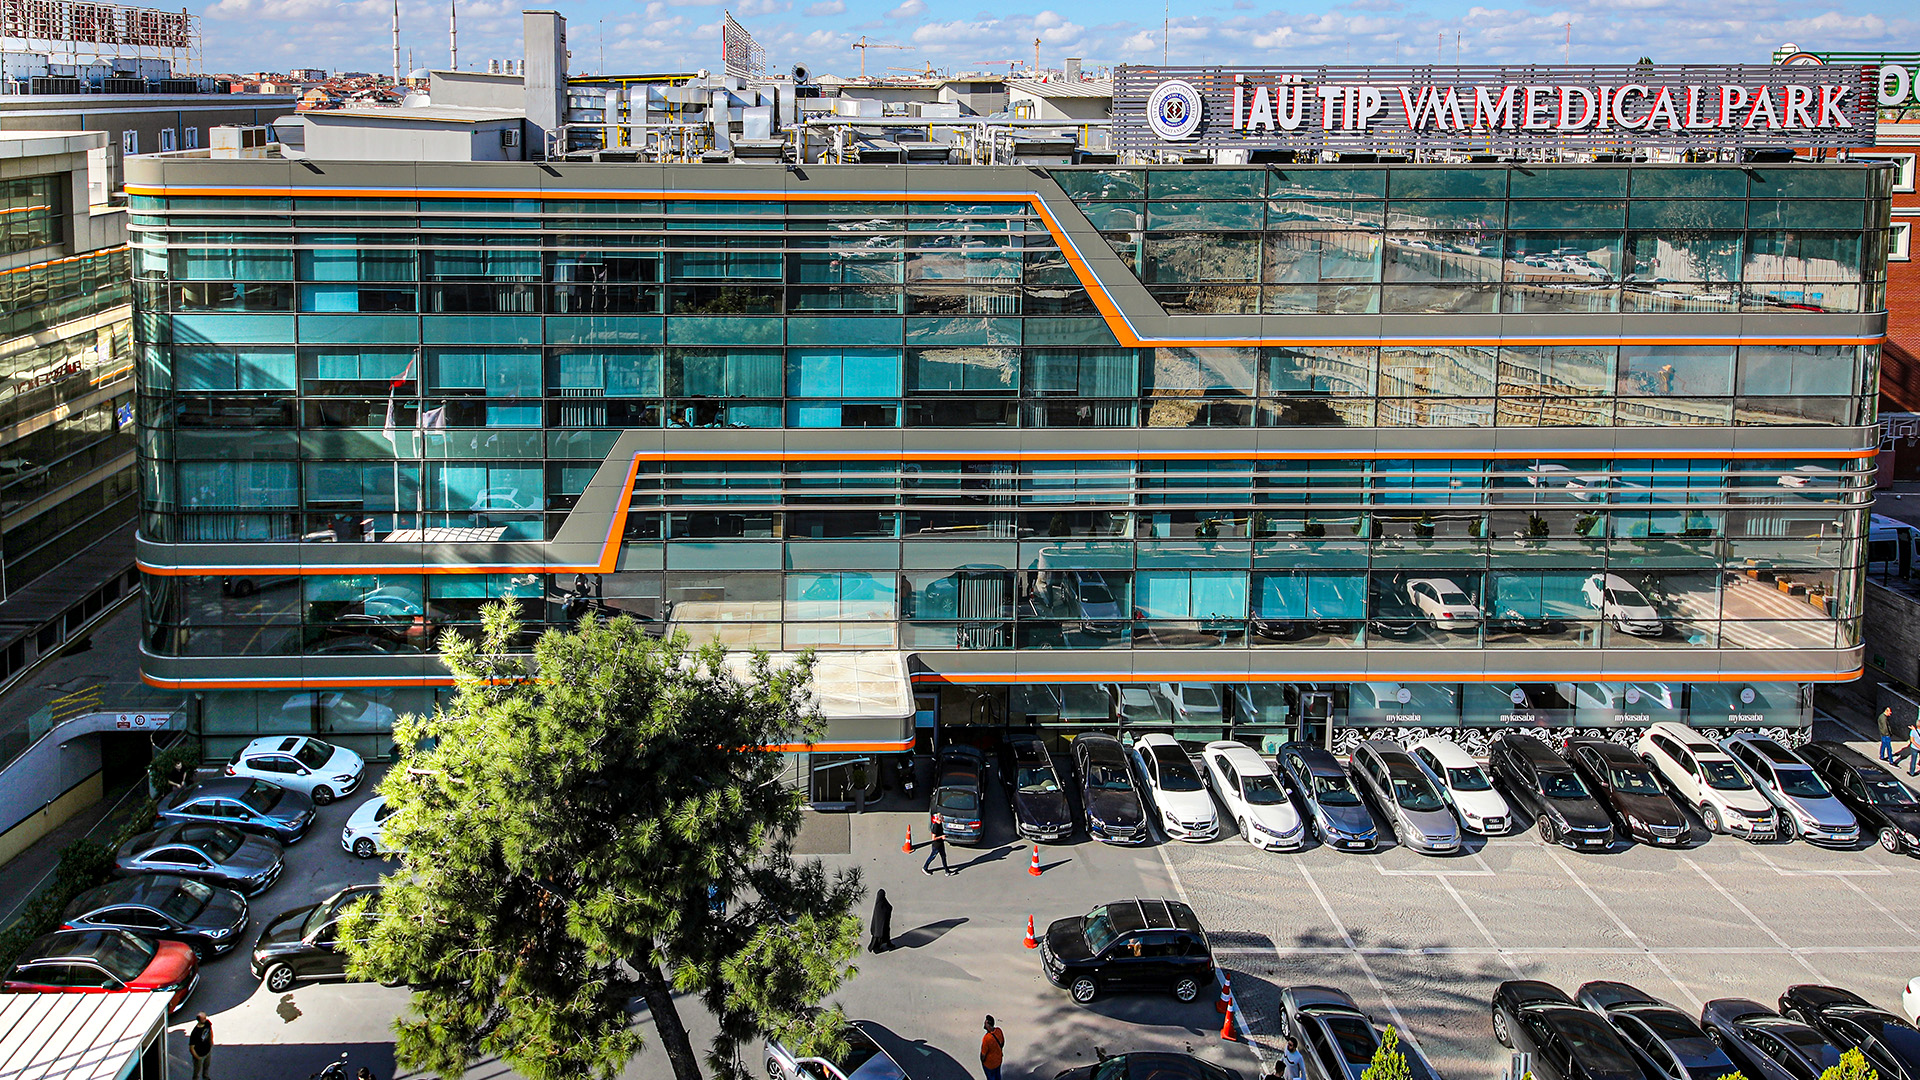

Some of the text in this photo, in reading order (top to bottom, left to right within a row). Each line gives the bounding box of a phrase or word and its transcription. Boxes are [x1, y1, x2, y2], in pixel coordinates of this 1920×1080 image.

[1232, 74, 1304, 130] İAÜ
[1317, 86, 1381, 130] TIP
[1386, 712, 1421, 724] mykasaba
[1500, 712, 1535, 724] mykasaba
[1614, 712, 1650, 724] mykasaba
[1728, 712, 1764, 724] mykasaba
